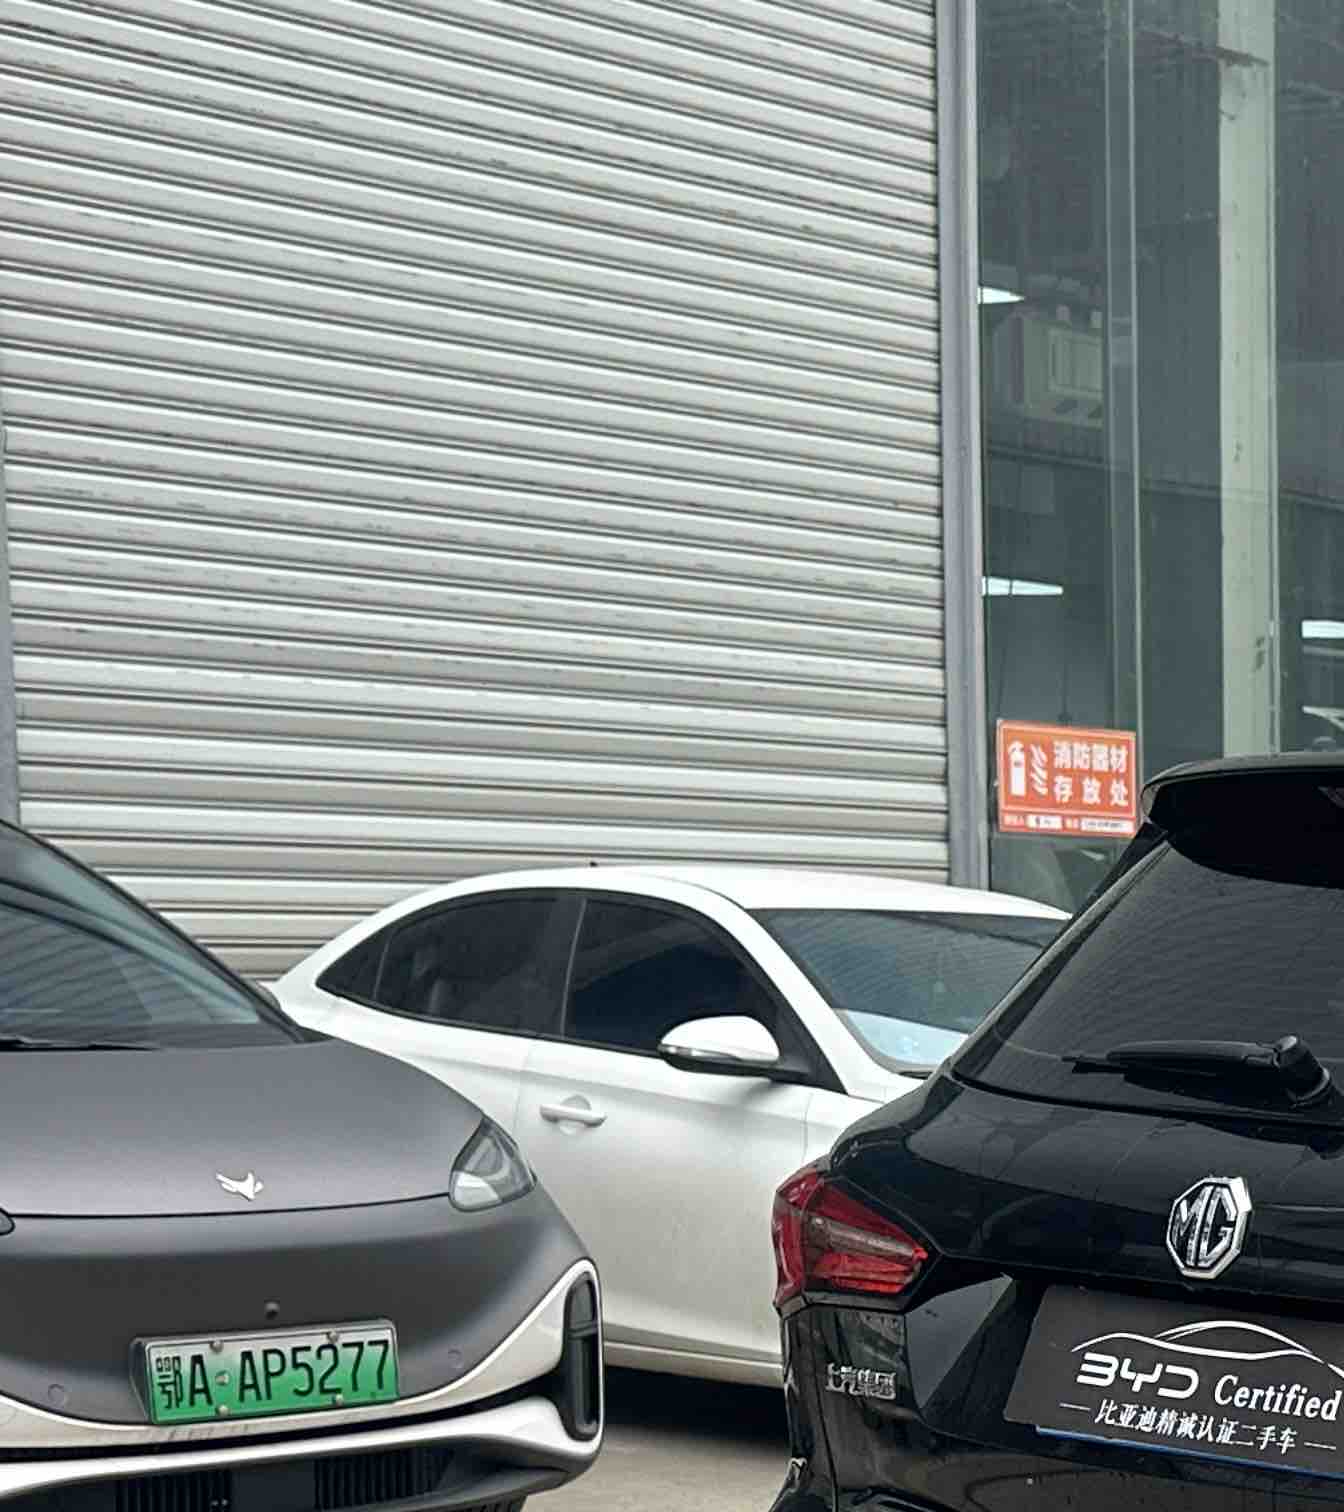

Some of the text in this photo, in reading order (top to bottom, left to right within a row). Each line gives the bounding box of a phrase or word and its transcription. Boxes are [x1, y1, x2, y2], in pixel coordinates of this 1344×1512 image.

[1053, 740, 1129, 773] 消防器材
[1053, 775, 1129, 807] 存放处
[1170, 1182, 1241, 1270] MG
[1076, 1351, 1343, 1422] BYD Certified
[1094, 1398, 1298, 1455] 比亚迪精诚认证二手车
